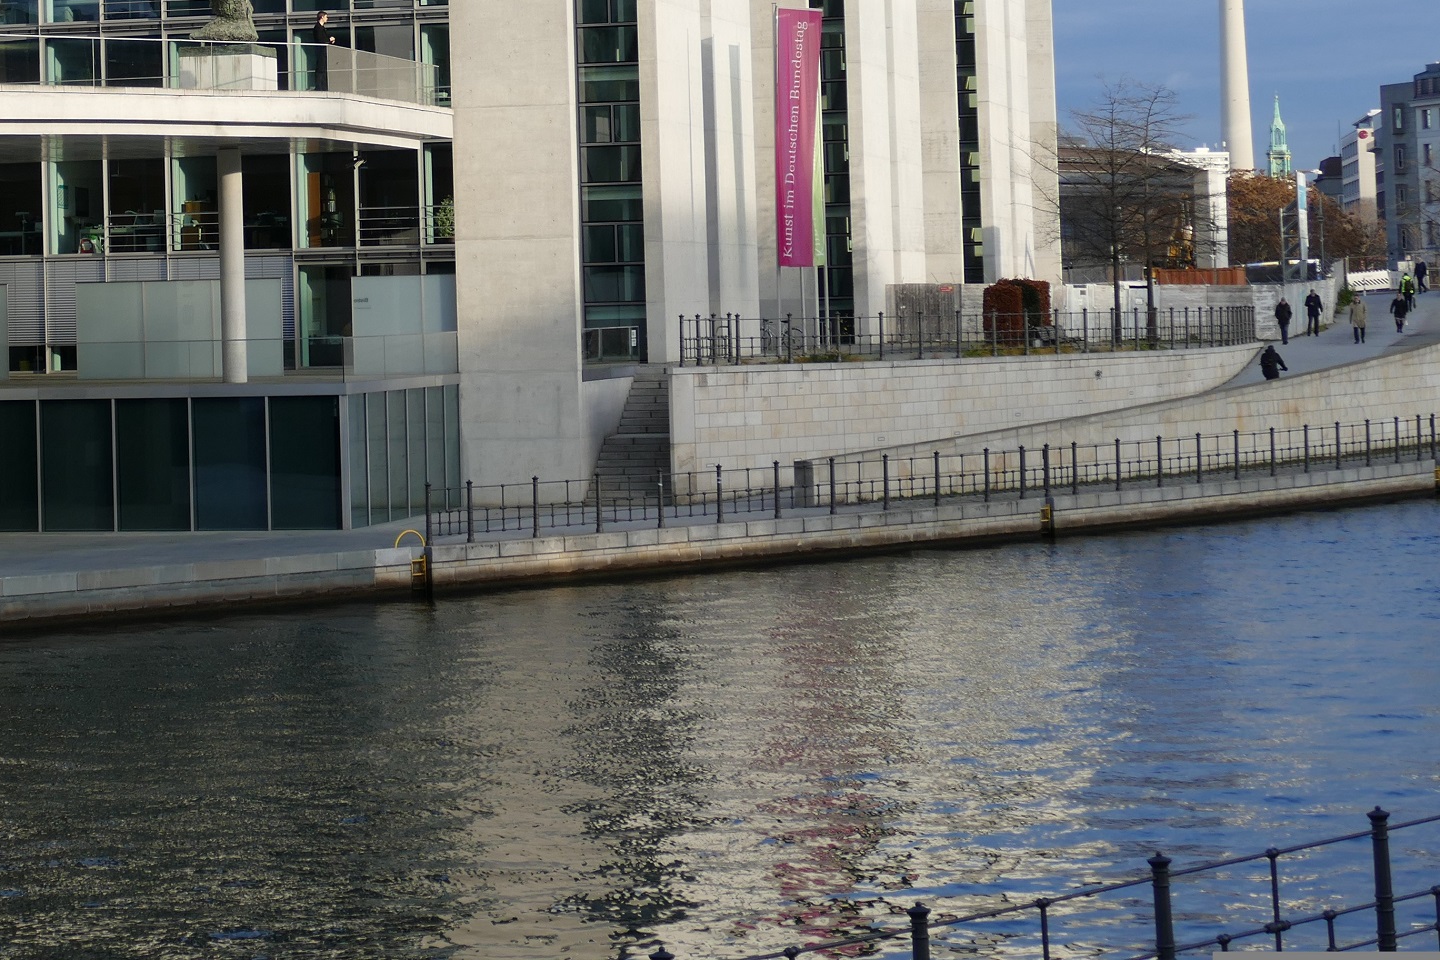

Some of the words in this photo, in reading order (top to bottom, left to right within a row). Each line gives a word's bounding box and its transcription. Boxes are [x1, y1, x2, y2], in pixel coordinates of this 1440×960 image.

[790, 21, 809, 100] Bundestag
[785, 105, 800, 184] Deutschen
[783, 190, 795, 208] im
[783, 214, 794, 258] Kunst
